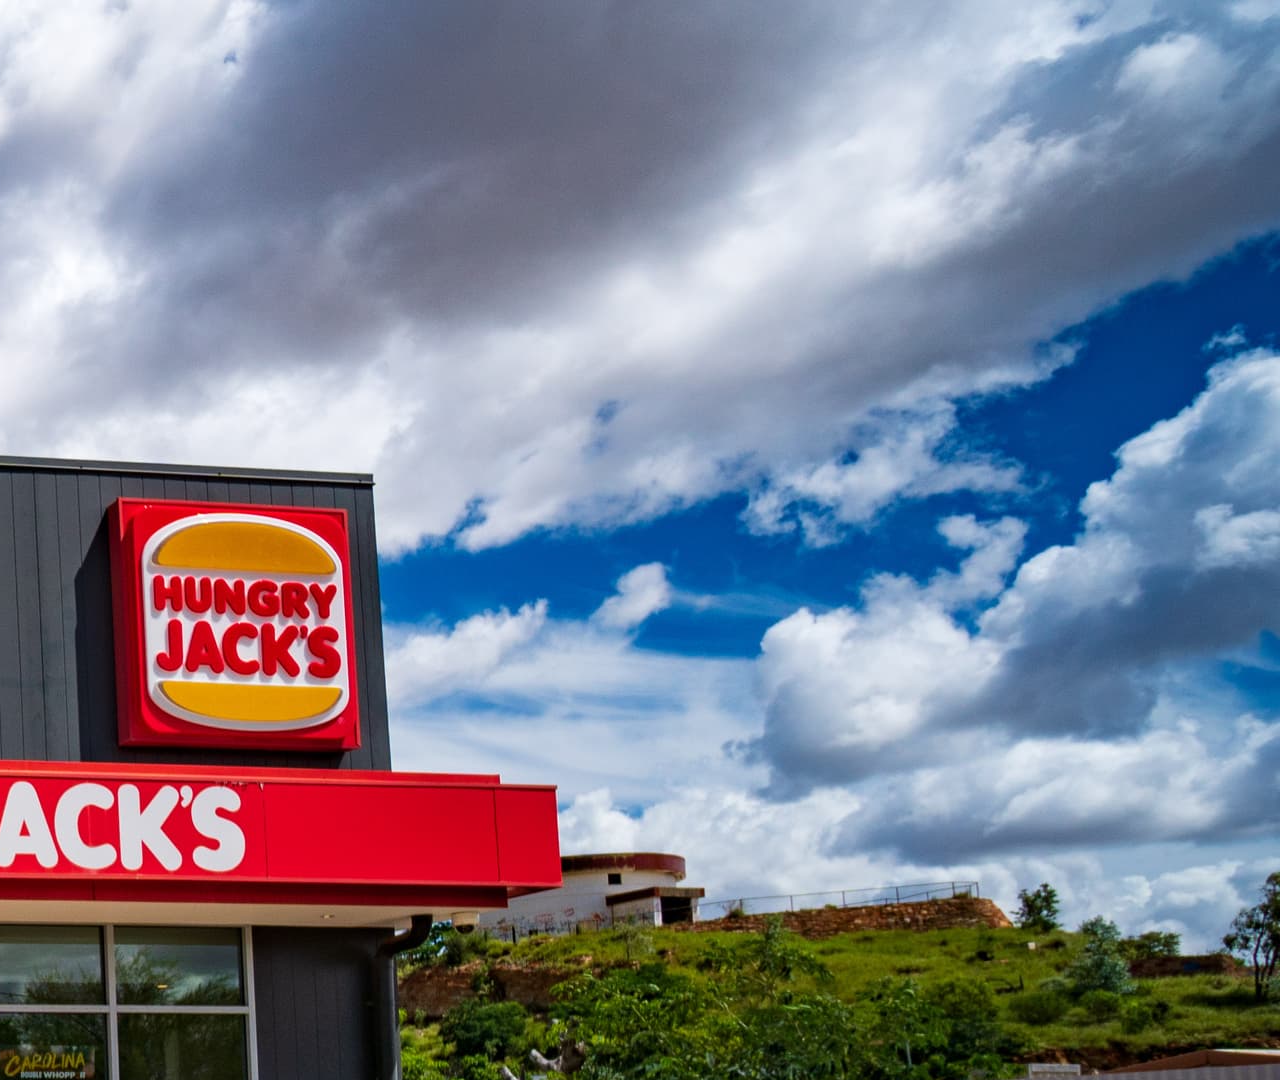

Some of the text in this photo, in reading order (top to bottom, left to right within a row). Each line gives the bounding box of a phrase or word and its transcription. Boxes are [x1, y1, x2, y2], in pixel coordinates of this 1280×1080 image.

[153, 575, 337, 619] HUNGRY
[156, 619, 341, 678] JACK'S
[4, 1051, 86, 1077] CAROLINA
